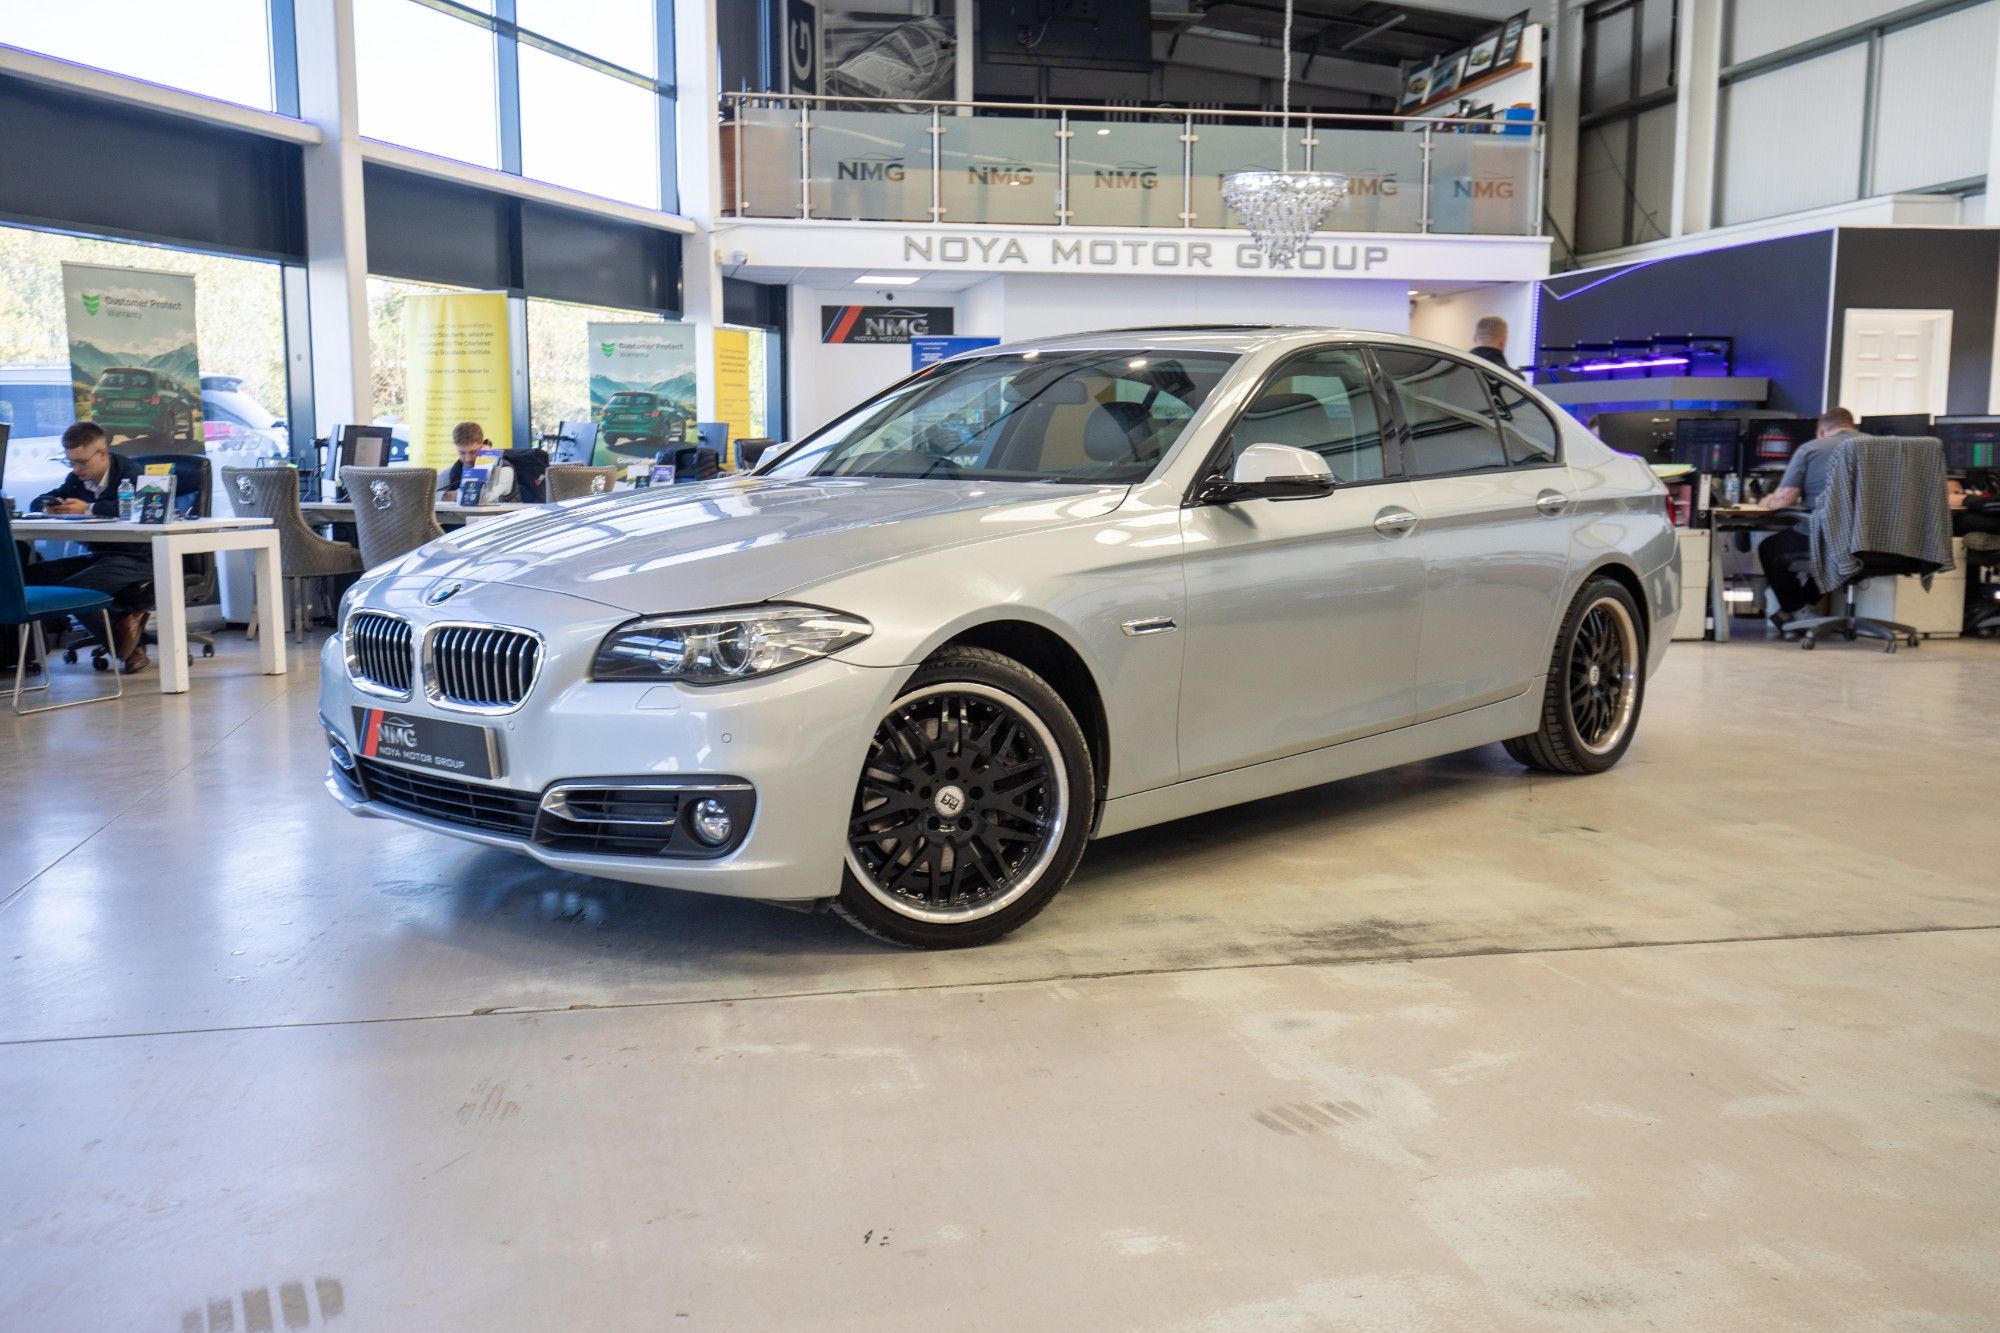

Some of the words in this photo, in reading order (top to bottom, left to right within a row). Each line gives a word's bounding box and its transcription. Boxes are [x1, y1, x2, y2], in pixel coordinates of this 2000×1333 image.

[838, 161, 905, 181] NMG
[968, 166, 1034, 185] NMG
[1094, 170, 1159, 189] NMG
[1454, 180, 1514, 199] NMG
[904, 236, 1028, 263] NOYA
[1052, 239, 1212, 267] MOTOR
[865, 318, 929, 336] NMG
[376, 723, 417, 748] NMG
[379, 746, 401, 757] NOYA
[403, 751, 433, 763] MOTOR
[434, 757, 465, 769] GROUP
